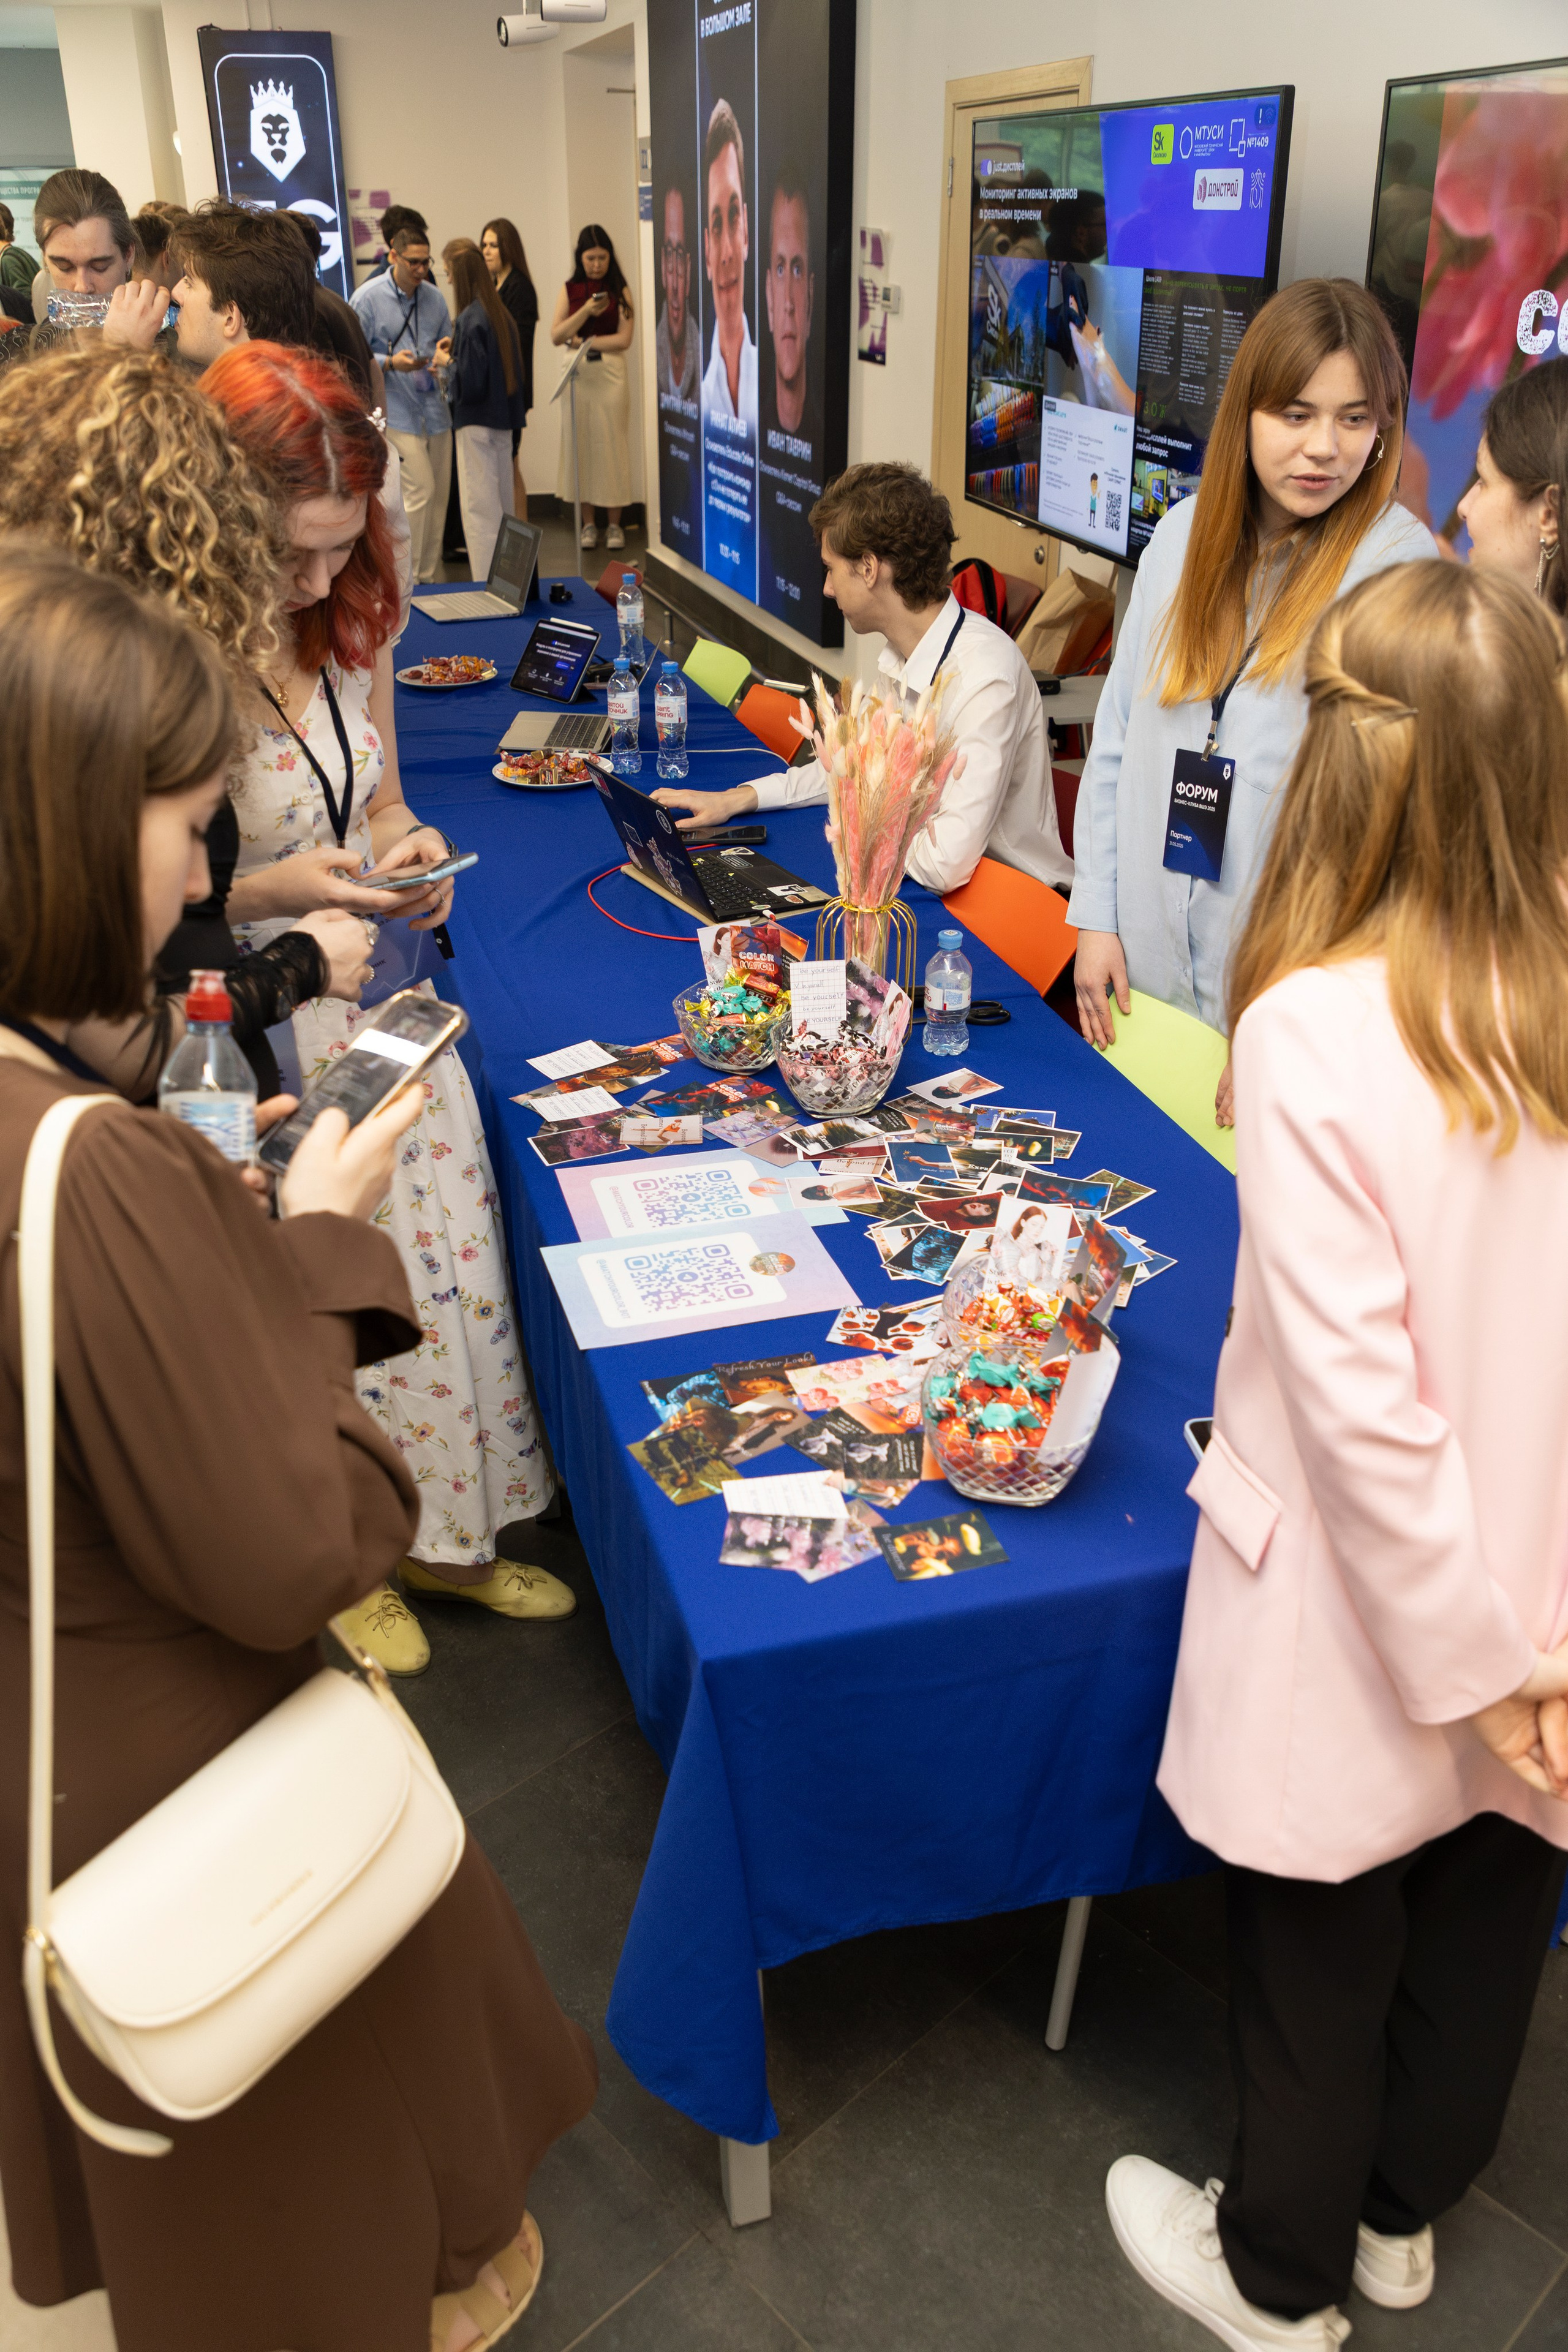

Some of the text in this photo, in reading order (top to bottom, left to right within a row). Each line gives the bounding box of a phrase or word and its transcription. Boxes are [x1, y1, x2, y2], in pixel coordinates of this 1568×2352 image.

[700, 2, 752, 38] В БОЛЬШОМ ЗАЛЕ
[1195, 124, 1224, 141] МТУСИ
[1154, 132, 1164, 151] Sk
[1247, 136, 1269, 148] №1409
[980, 187, 1078, 203] Мониторинг активных экранов
[1208, 179, 1238, 197] ДОНСТРОЙ
[979, 208, 1041, 223] в реальном времени
[1136, 442, 1168, 458] любой запрос
[1167, 438, 1193, 451] выполнит
[1176, 781, 1218, 804] ФОРУМ
[1174, 798, 1199, 809] БИЗНЕС-КЛУБА
[1170, 830, 1193, 843] Партнер
[739, 951, 775, 962] COLOR
[740, 960, 775, 971] MATCH
[811, 965, 840, 976] yourself
[813, 992, 845, 1001] yourself
[609, 1186, 635, 1229] @MATCHYOURCOLOR
[989, 1268, 1007, 1277] Style
[597, 1258, 631, 1319] @MATCHYOURCOLOR_BOT
[716, 1360, 756, 1376] Refresh
